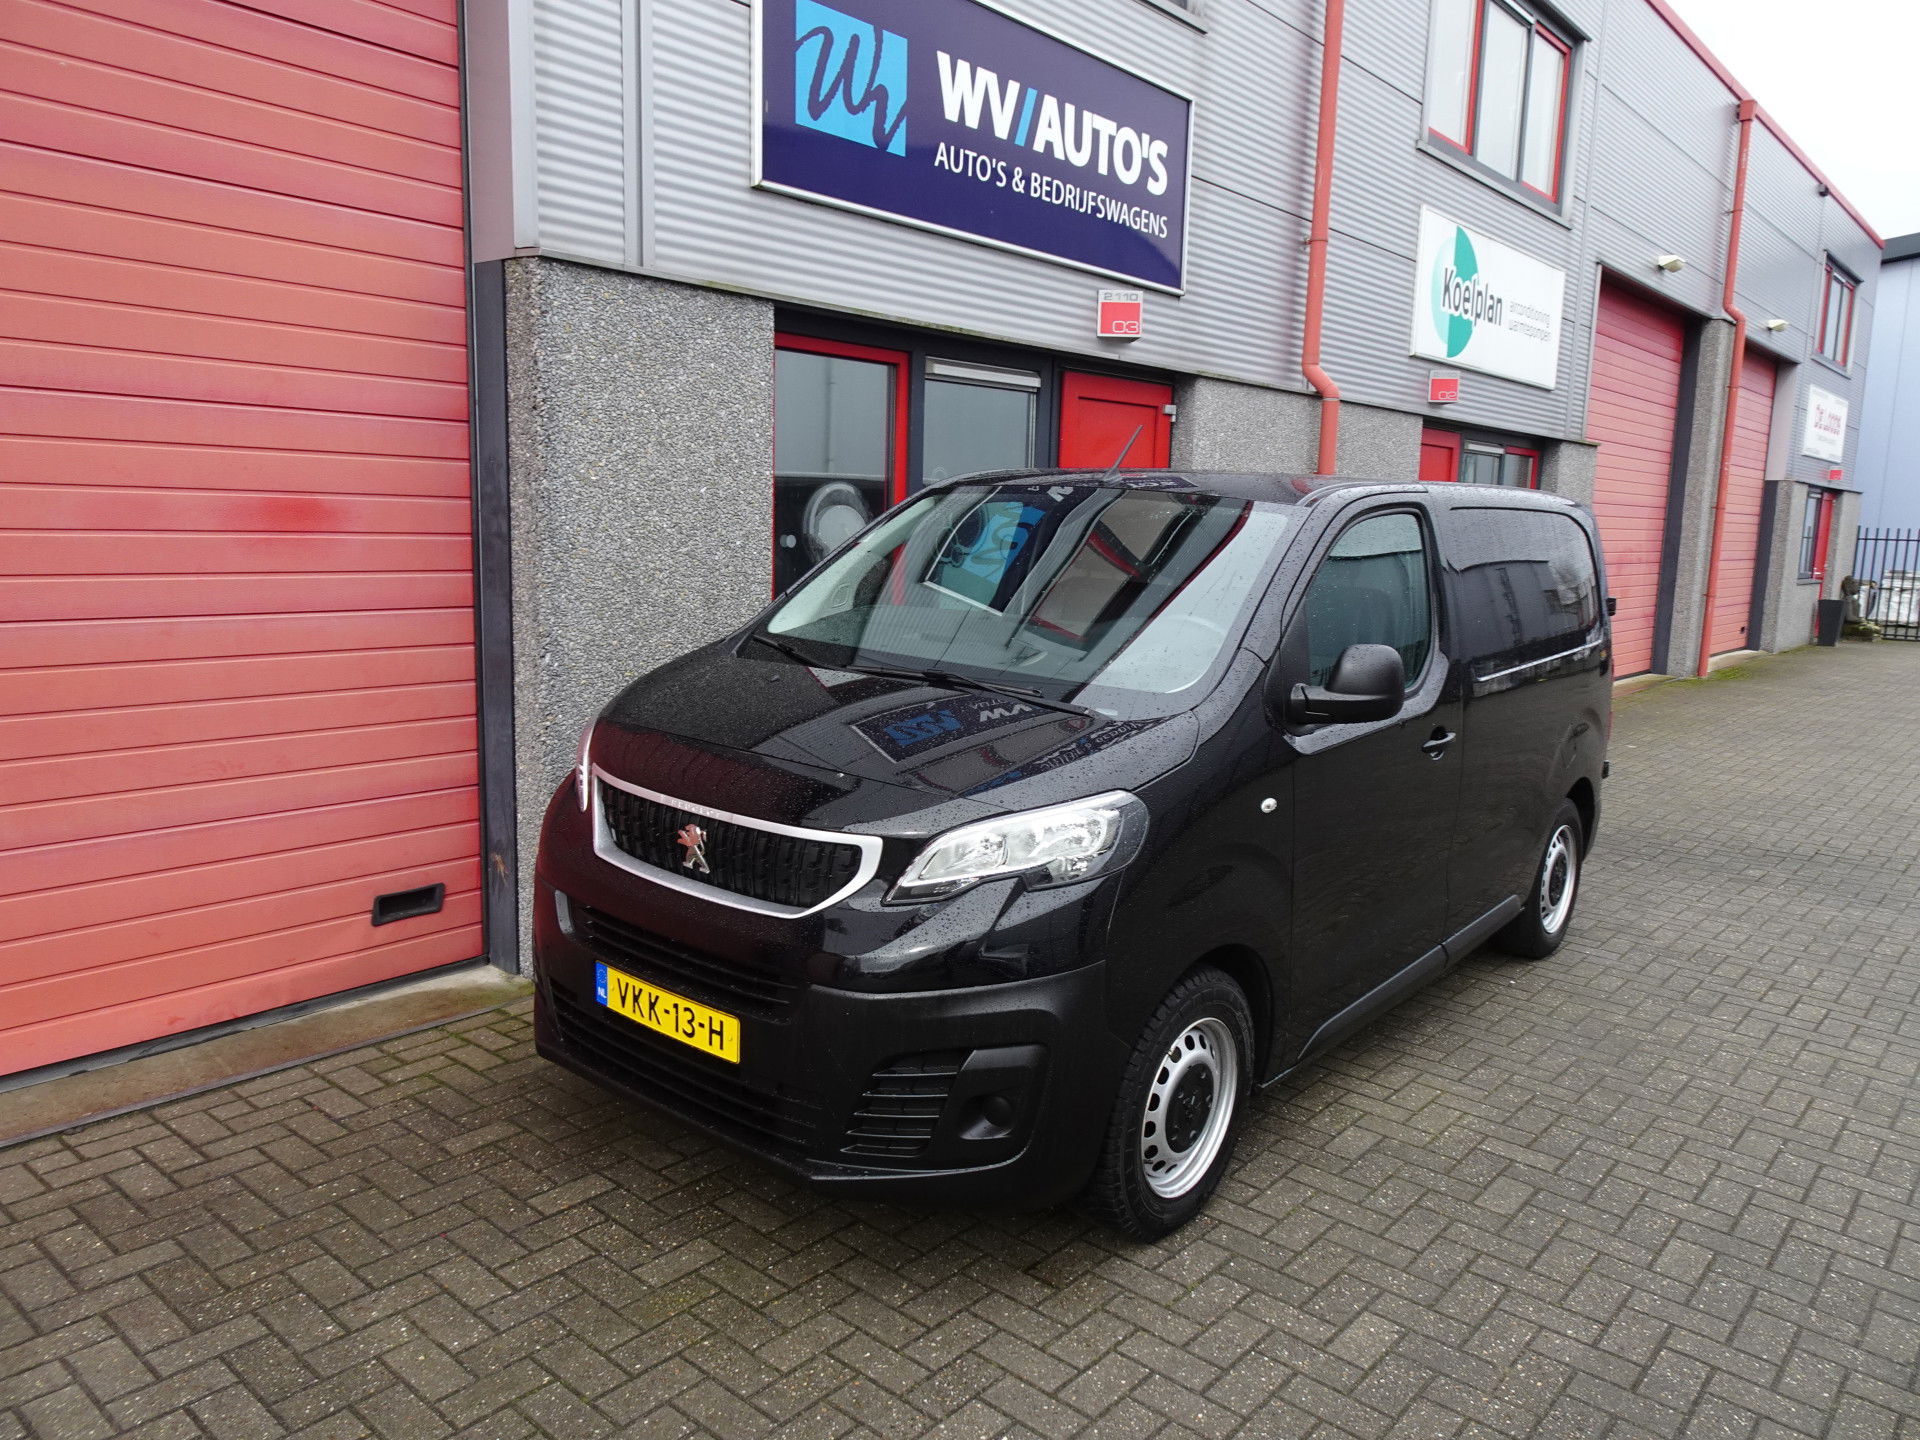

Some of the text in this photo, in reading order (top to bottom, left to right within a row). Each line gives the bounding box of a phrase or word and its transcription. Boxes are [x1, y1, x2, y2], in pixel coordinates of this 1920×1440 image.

[934, 141, 1168, 239] AUTO'S & BEDRIJFSWAGENS
[1103, 291, 1139, 301] 2110
[1442, 267, 1504, 327] Koelplan
[1112, 320, 1139, 333] 03
[616, 977, 724, 1051] VKK-13-H
